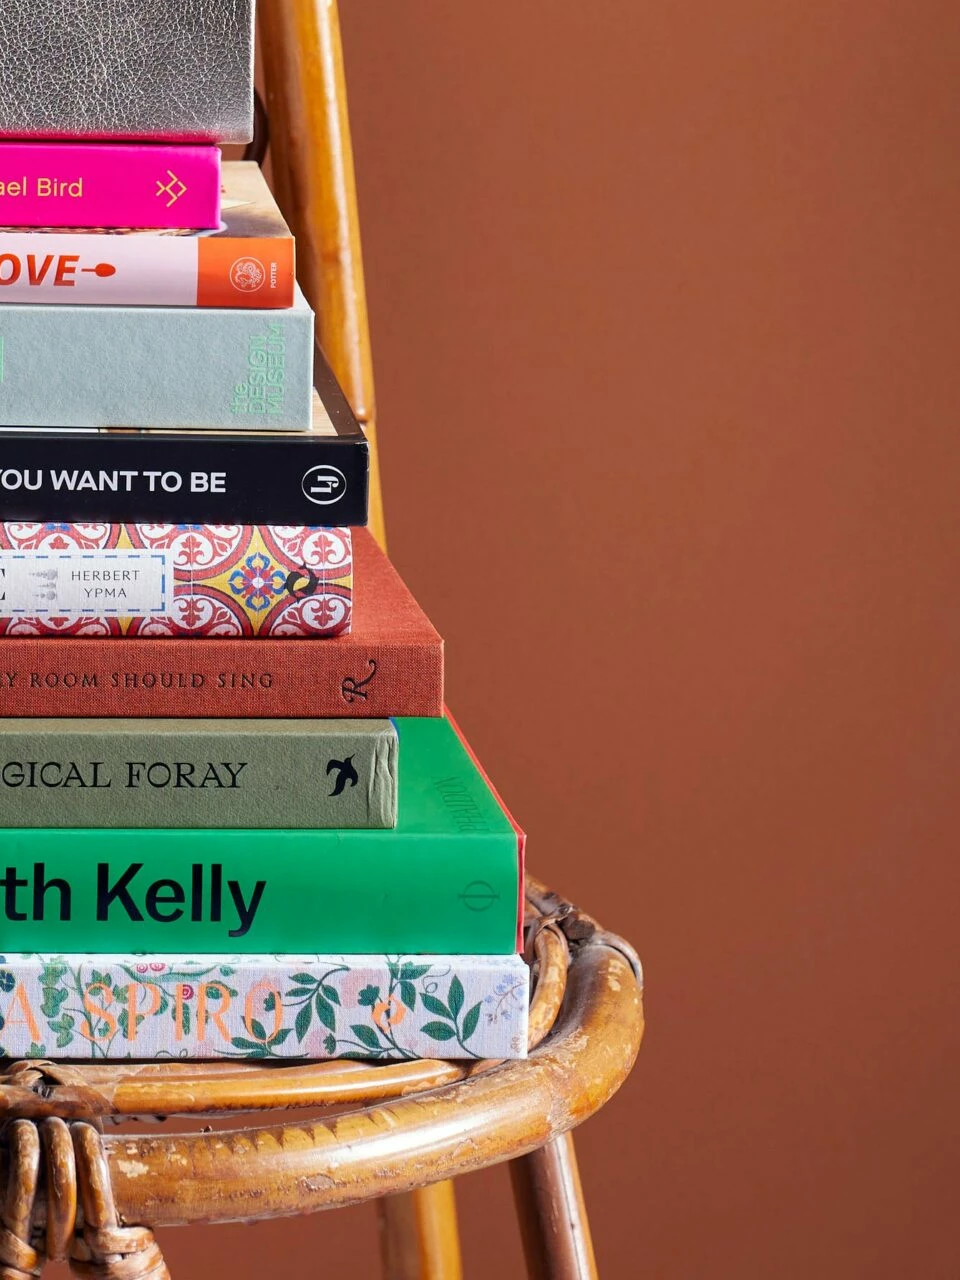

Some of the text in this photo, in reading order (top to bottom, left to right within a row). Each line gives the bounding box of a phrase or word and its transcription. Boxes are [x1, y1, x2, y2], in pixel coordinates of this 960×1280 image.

[38, 178, 83, 198] Bird
[249, 335, 266, 414] DESIGN
[267, 323, 286, 415] MUSEUM
[231, 383, 248, 414] the
[50, 470, 138, 492] WANT
[143, 471, 183, 492] TO
[190, 472, 226, 493] BE
[71, 570, 140, 582] HERBERT
[84, 587, 127, 599] YPMA
[30, 673, 100, 689] ROOM
[110, 673, 207, 689] SHOULD
[217, 674, 274, 689] SING
[125, 762, 248, 789] FORAY
[96, 862, 268, 938] Kelly
[80, 980, 283, 1046] SPIRO
